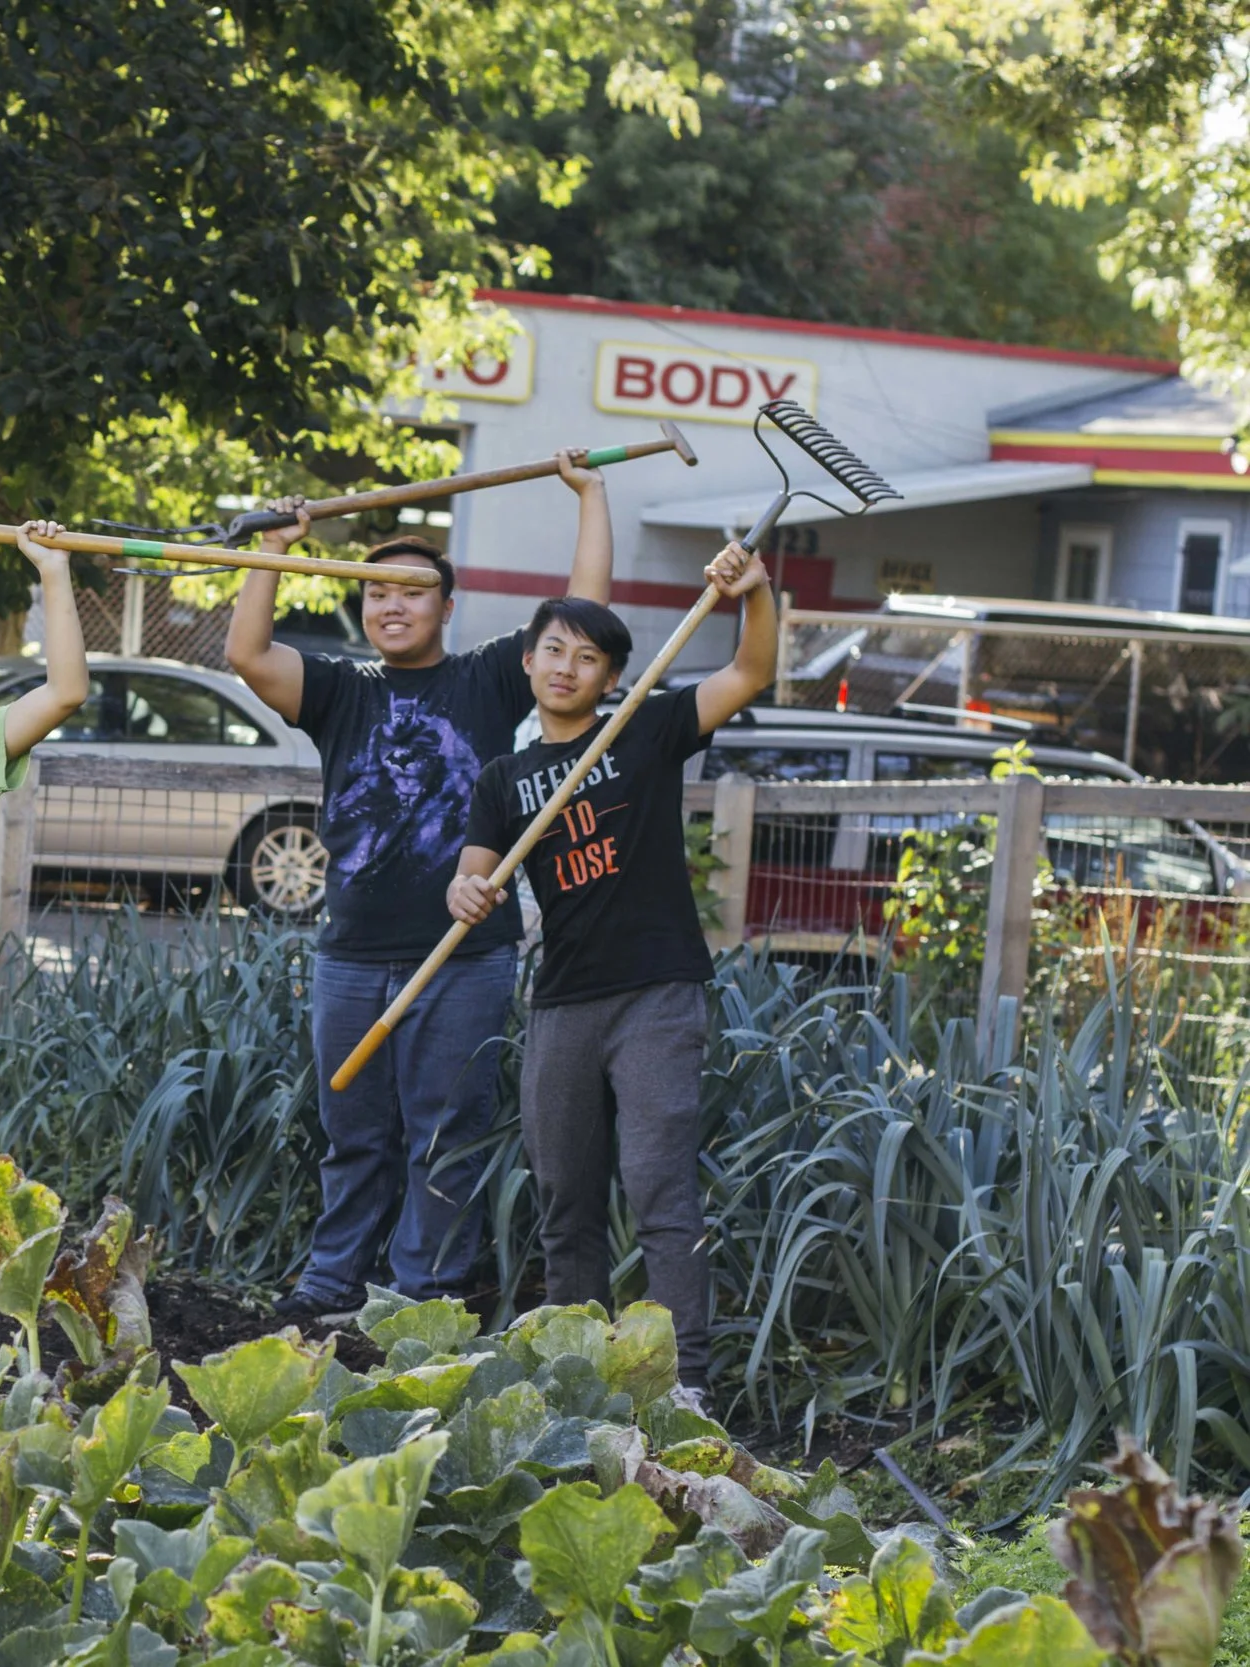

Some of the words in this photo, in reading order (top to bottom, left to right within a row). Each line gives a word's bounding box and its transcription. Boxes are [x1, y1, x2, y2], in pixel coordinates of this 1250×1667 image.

[614, 355, 797, 410] BODY
[558, 800, 597, 843] TO
[554, 836, 620, 891] LOSE
